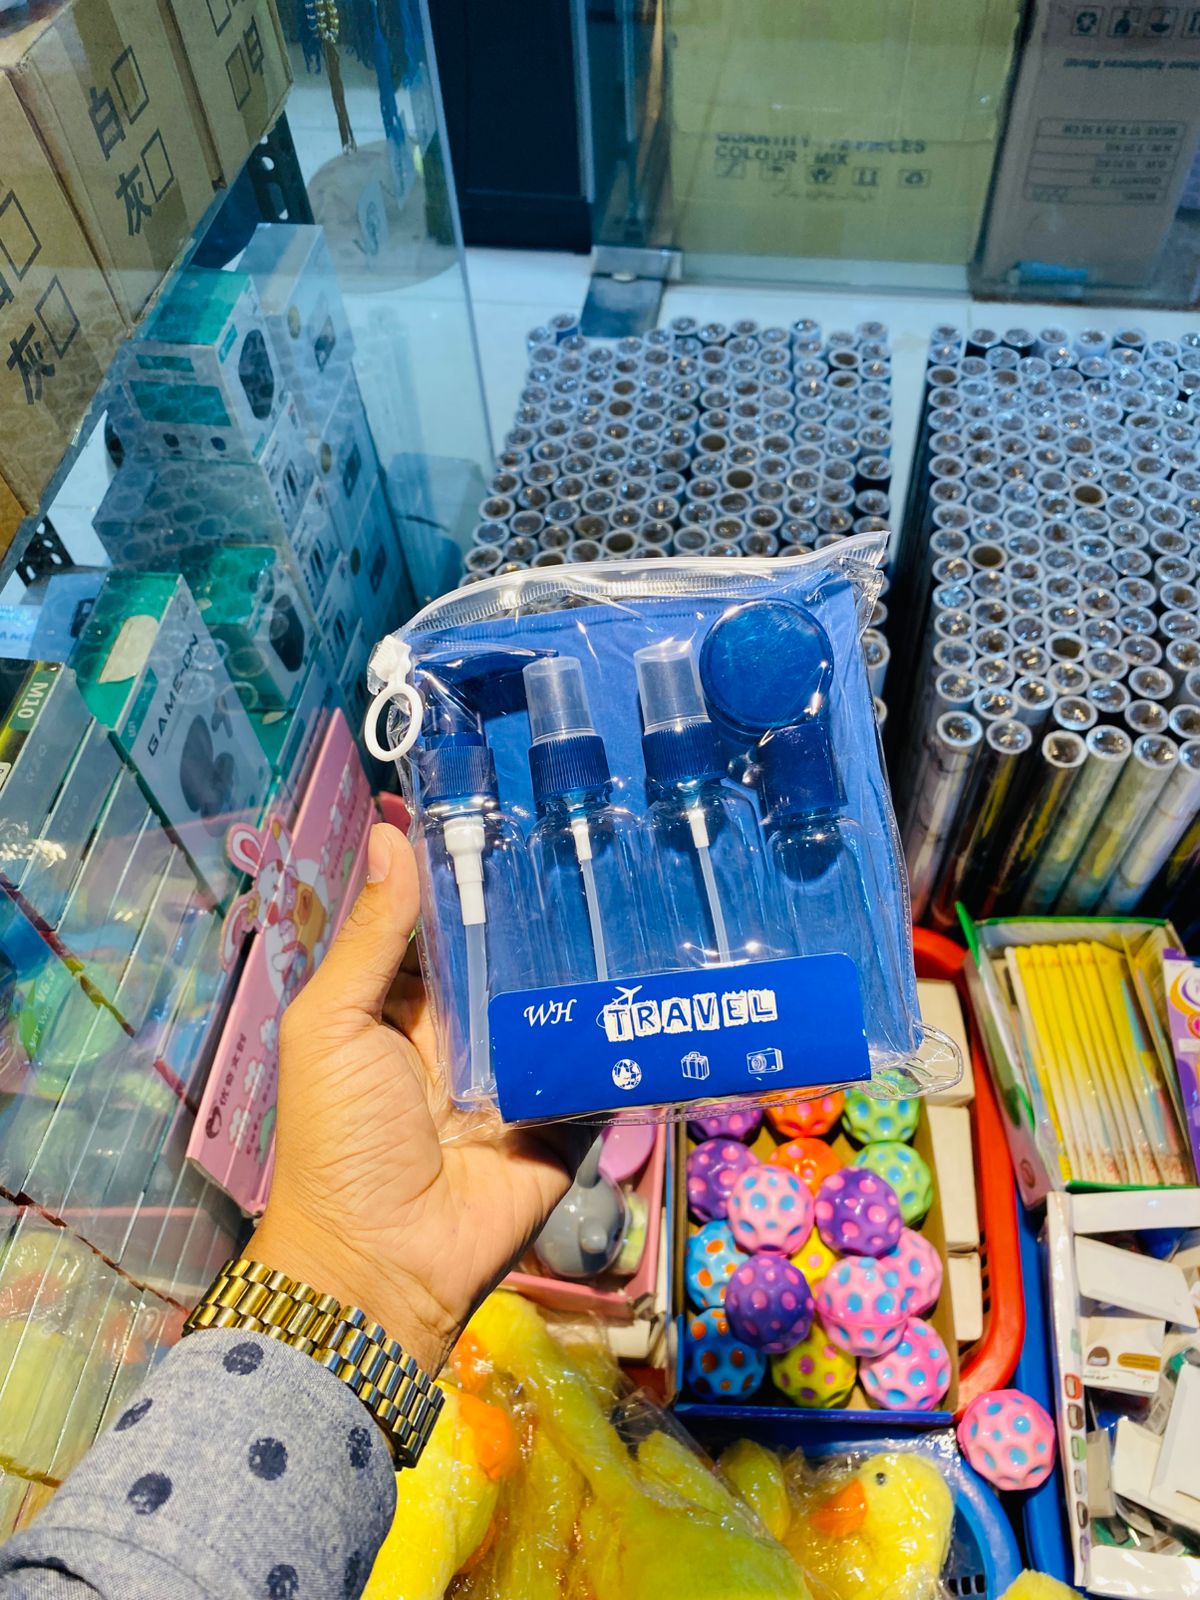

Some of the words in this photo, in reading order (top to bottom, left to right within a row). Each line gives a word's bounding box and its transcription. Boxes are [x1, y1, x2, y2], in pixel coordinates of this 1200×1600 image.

[89, 86, 126, 161] 白
[715, 145, 797, 163] COLOUR
[116, 164, 153, 236] 灰
[7, 323, 55, 404] 灰
[17, 682, 49, 719] M10
[147, 633, 199, 757] GAME-ON
[524, 999, 577, 1027] WH
[603, 989, 778, 1041] TRAVEL
